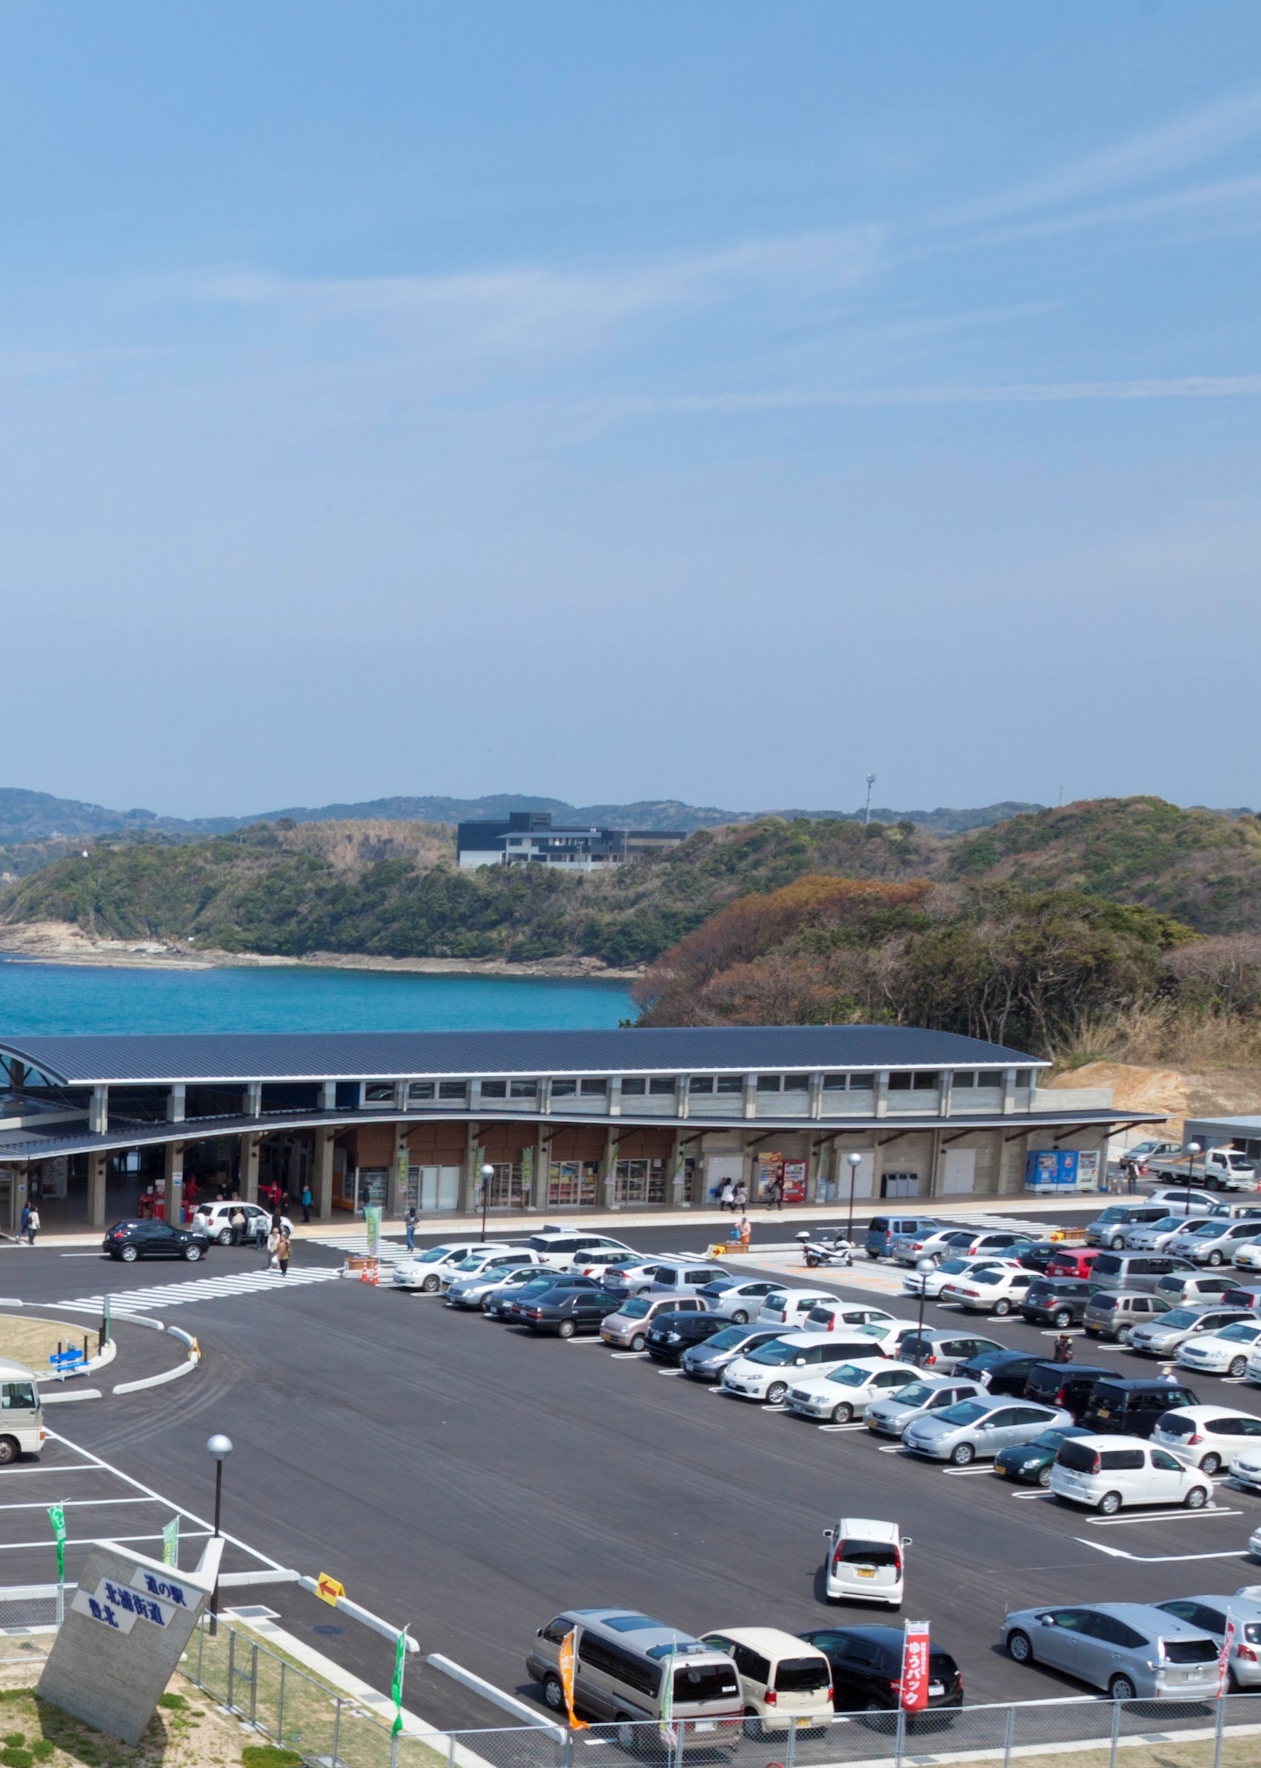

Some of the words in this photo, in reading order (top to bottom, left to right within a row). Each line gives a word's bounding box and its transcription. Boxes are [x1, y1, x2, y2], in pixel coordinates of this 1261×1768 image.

[105, 1582, 165, 1626] 北浦街道
[143, 1573, 187, 1607] 道の駅
[88, 1597, 119, 1628] 豊北
[905, 1641, 921, 1706] ゆうパック
